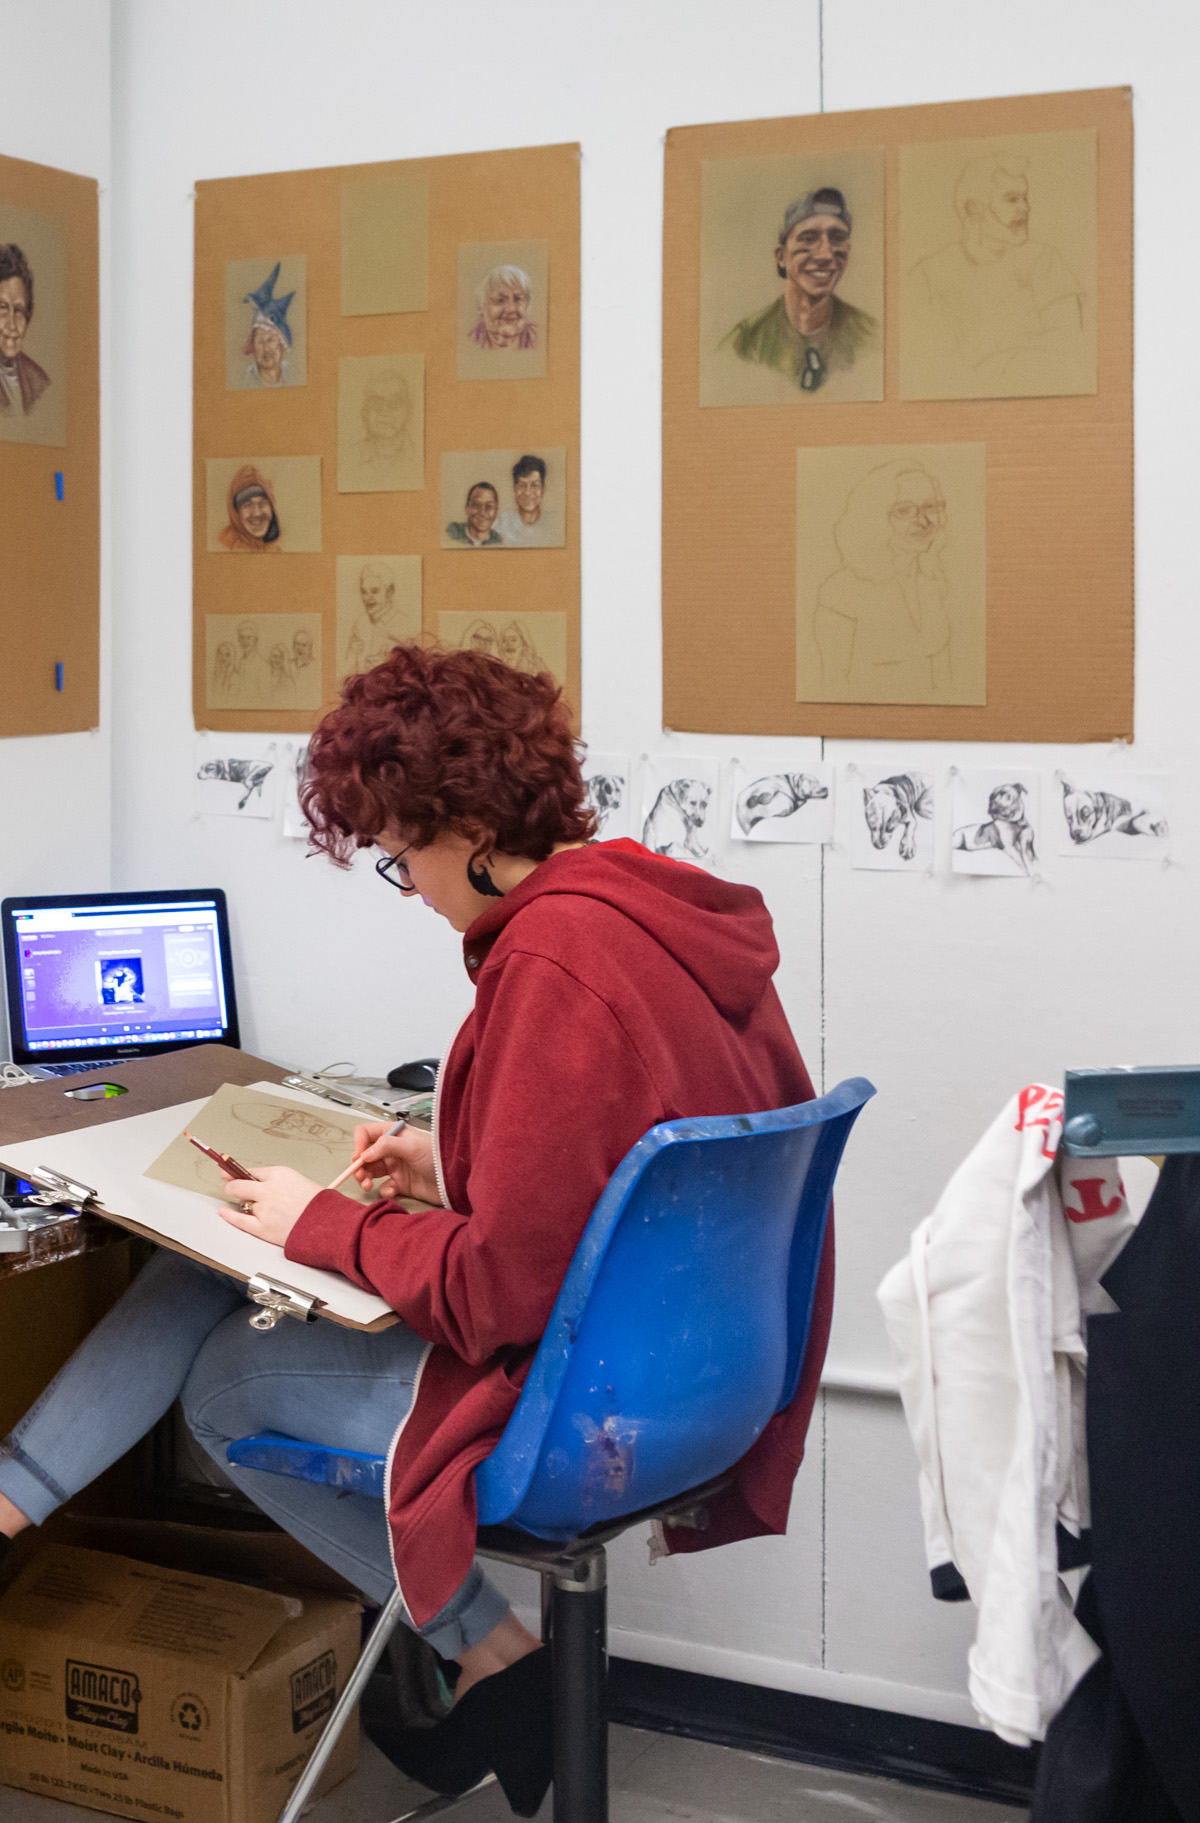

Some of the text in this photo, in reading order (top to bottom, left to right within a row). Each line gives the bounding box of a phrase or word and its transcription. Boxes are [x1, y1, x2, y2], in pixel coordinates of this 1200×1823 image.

[71, 1667, 131, 1707] AMACO
[27, 1725, 58, 1743] Moite
[68, 1735, 98, 1752] Moist
[101, 1743, 126, 1760] Clay
[134, 1751, 170, 1770] Arcilla
[173, 1760, 223, 1782] Húmeda
[80, 1762, 101, 1775] Made
[112, 1770, 129, 1782] USA
[124, 1794, 134, 1806] lb
[135, 1797, 163, 1814] Plastic
[164, 1805, 185, 1820] Bags
